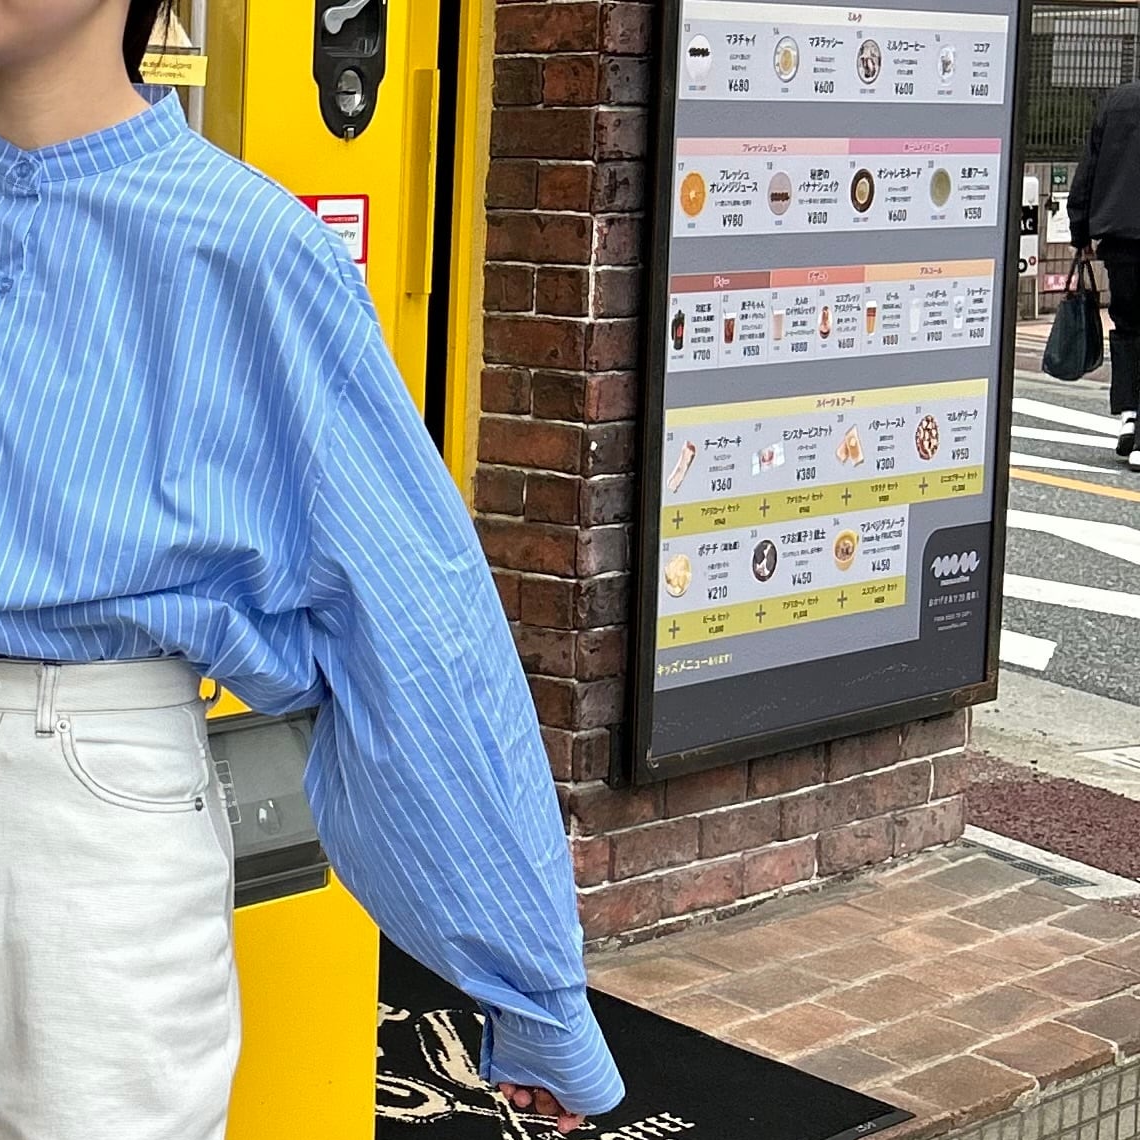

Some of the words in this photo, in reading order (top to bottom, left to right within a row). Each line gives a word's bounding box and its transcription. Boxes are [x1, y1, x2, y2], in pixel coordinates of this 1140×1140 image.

[887, 40, 925, 51] ミルクコーヒー
[974, 43, 990, 53] ココア
[728, 79, 749, 92] ¥680
[814, 81, 834, 94] ¥600
[895, 83, 914, 95] ¥600
[720, 170, 749, 180] フレッシュ
[877, 168, 922, 179] オシャレモネード
[710, 182, 758, 193] オレンジジュース
[798, 182, 838, 193] バナナシェイク
[808, 212, 827, 224] ¥800
[888, 210, 907, 222] ¥600
[964, 207, 982, 220] ¥550
[723, 214, 743, 227] ¥980
[886, 292, 899, 300] ビール
[925, 290, 947, 299] ハイボール
[947, 409, 978, 421] マルゲリータ
[869, 417, 905, 430] バタートースト
[782, 425, 832, 440] モンスタービスケット
[704, 436, 742, 450] チーズケーキ
[952, 448, 969, 460] ¥950
[876, 457, 895, 470] ¥300
[796, 467, 816, 480] ¥380
[711, 478, 732, 492] ¥360
[698, 543, 718, 556] ポテチ
[872, 558, 890, 572] ¥450
[792, 572, 812, 586] ¥450
[708, 586, 728, 600] ¥210
